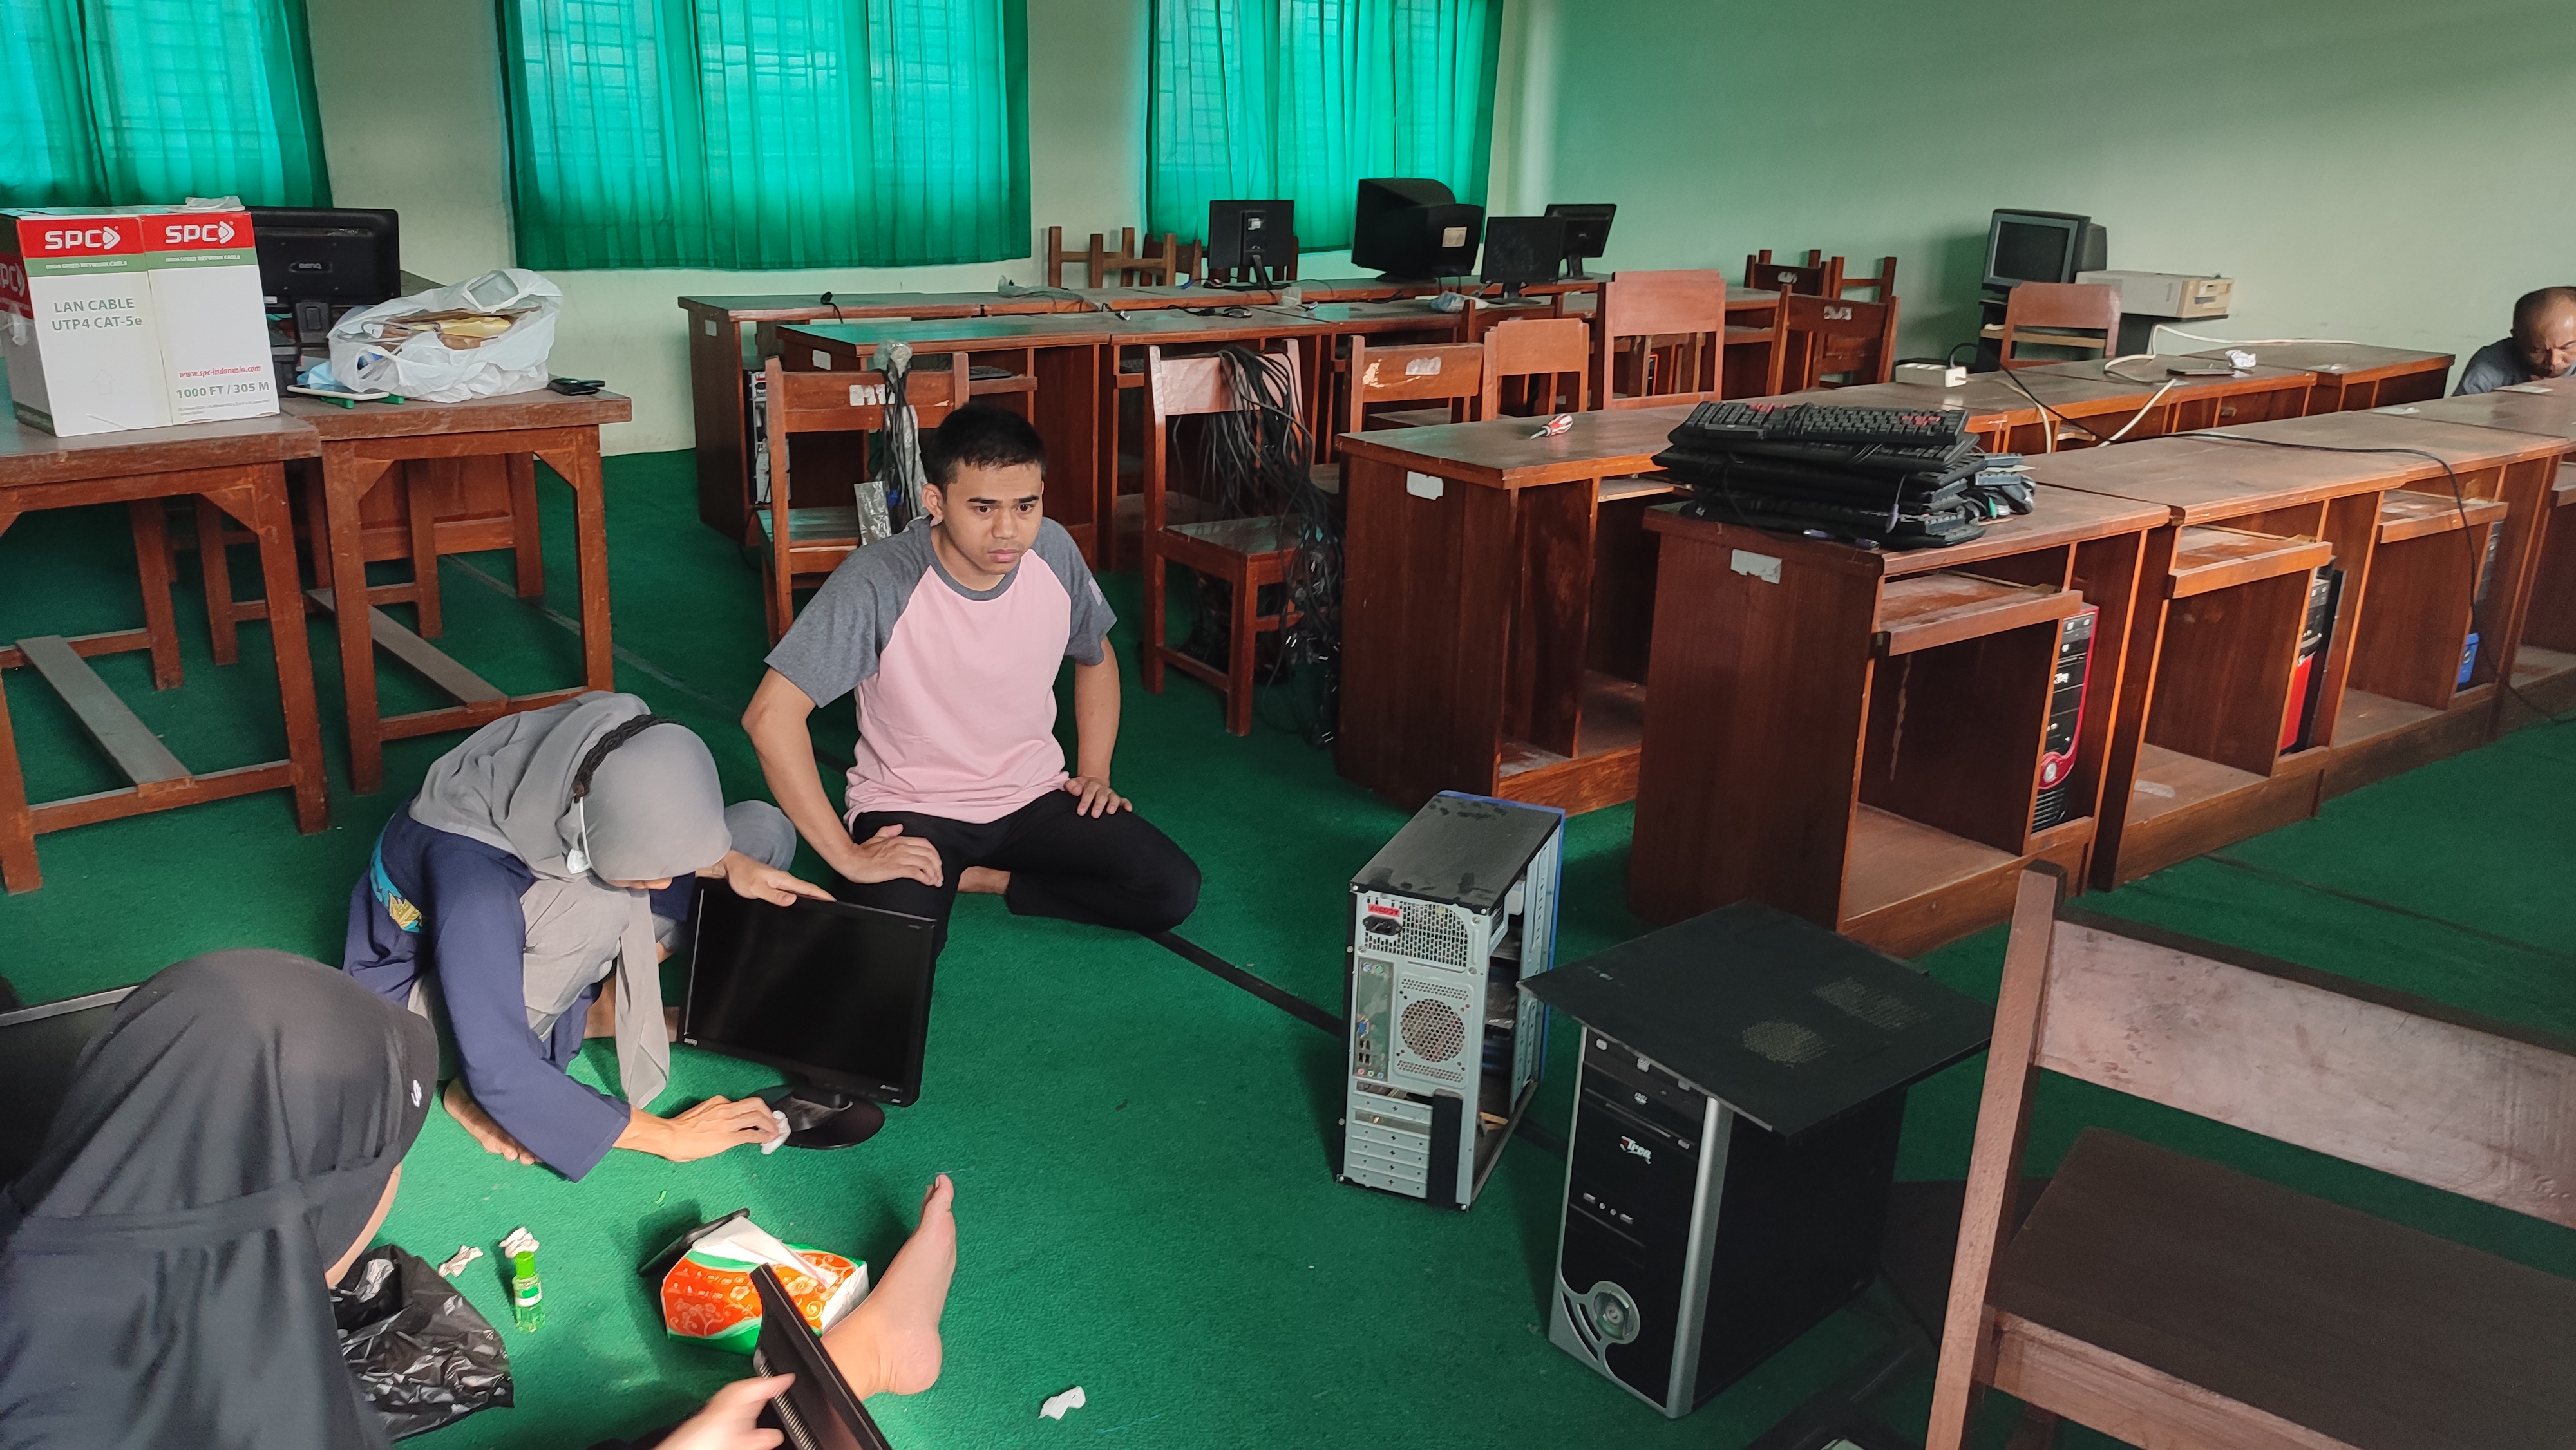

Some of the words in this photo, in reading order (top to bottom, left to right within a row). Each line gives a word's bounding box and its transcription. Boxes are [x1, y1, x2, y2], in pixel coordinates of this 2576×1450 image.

[44, 229, 102, 250] SPC
[165, 224, 218, 244] SPC
[54, 301, 84, 313] LAN
[88, 298, 135, 311] CABLE
[52, 318, 90, 331] UTP4
[93, 316, 142, 328] CAT-5e
[179, 366, 261, 378] www.spc-indonesia.com
[176, 388, 207, 399] 1000
[209, 386, 223, 395] FT
[227, 384, 231, 395] /
[234, 383, 256, 393] 305
[259, 381, 270, 391] M
